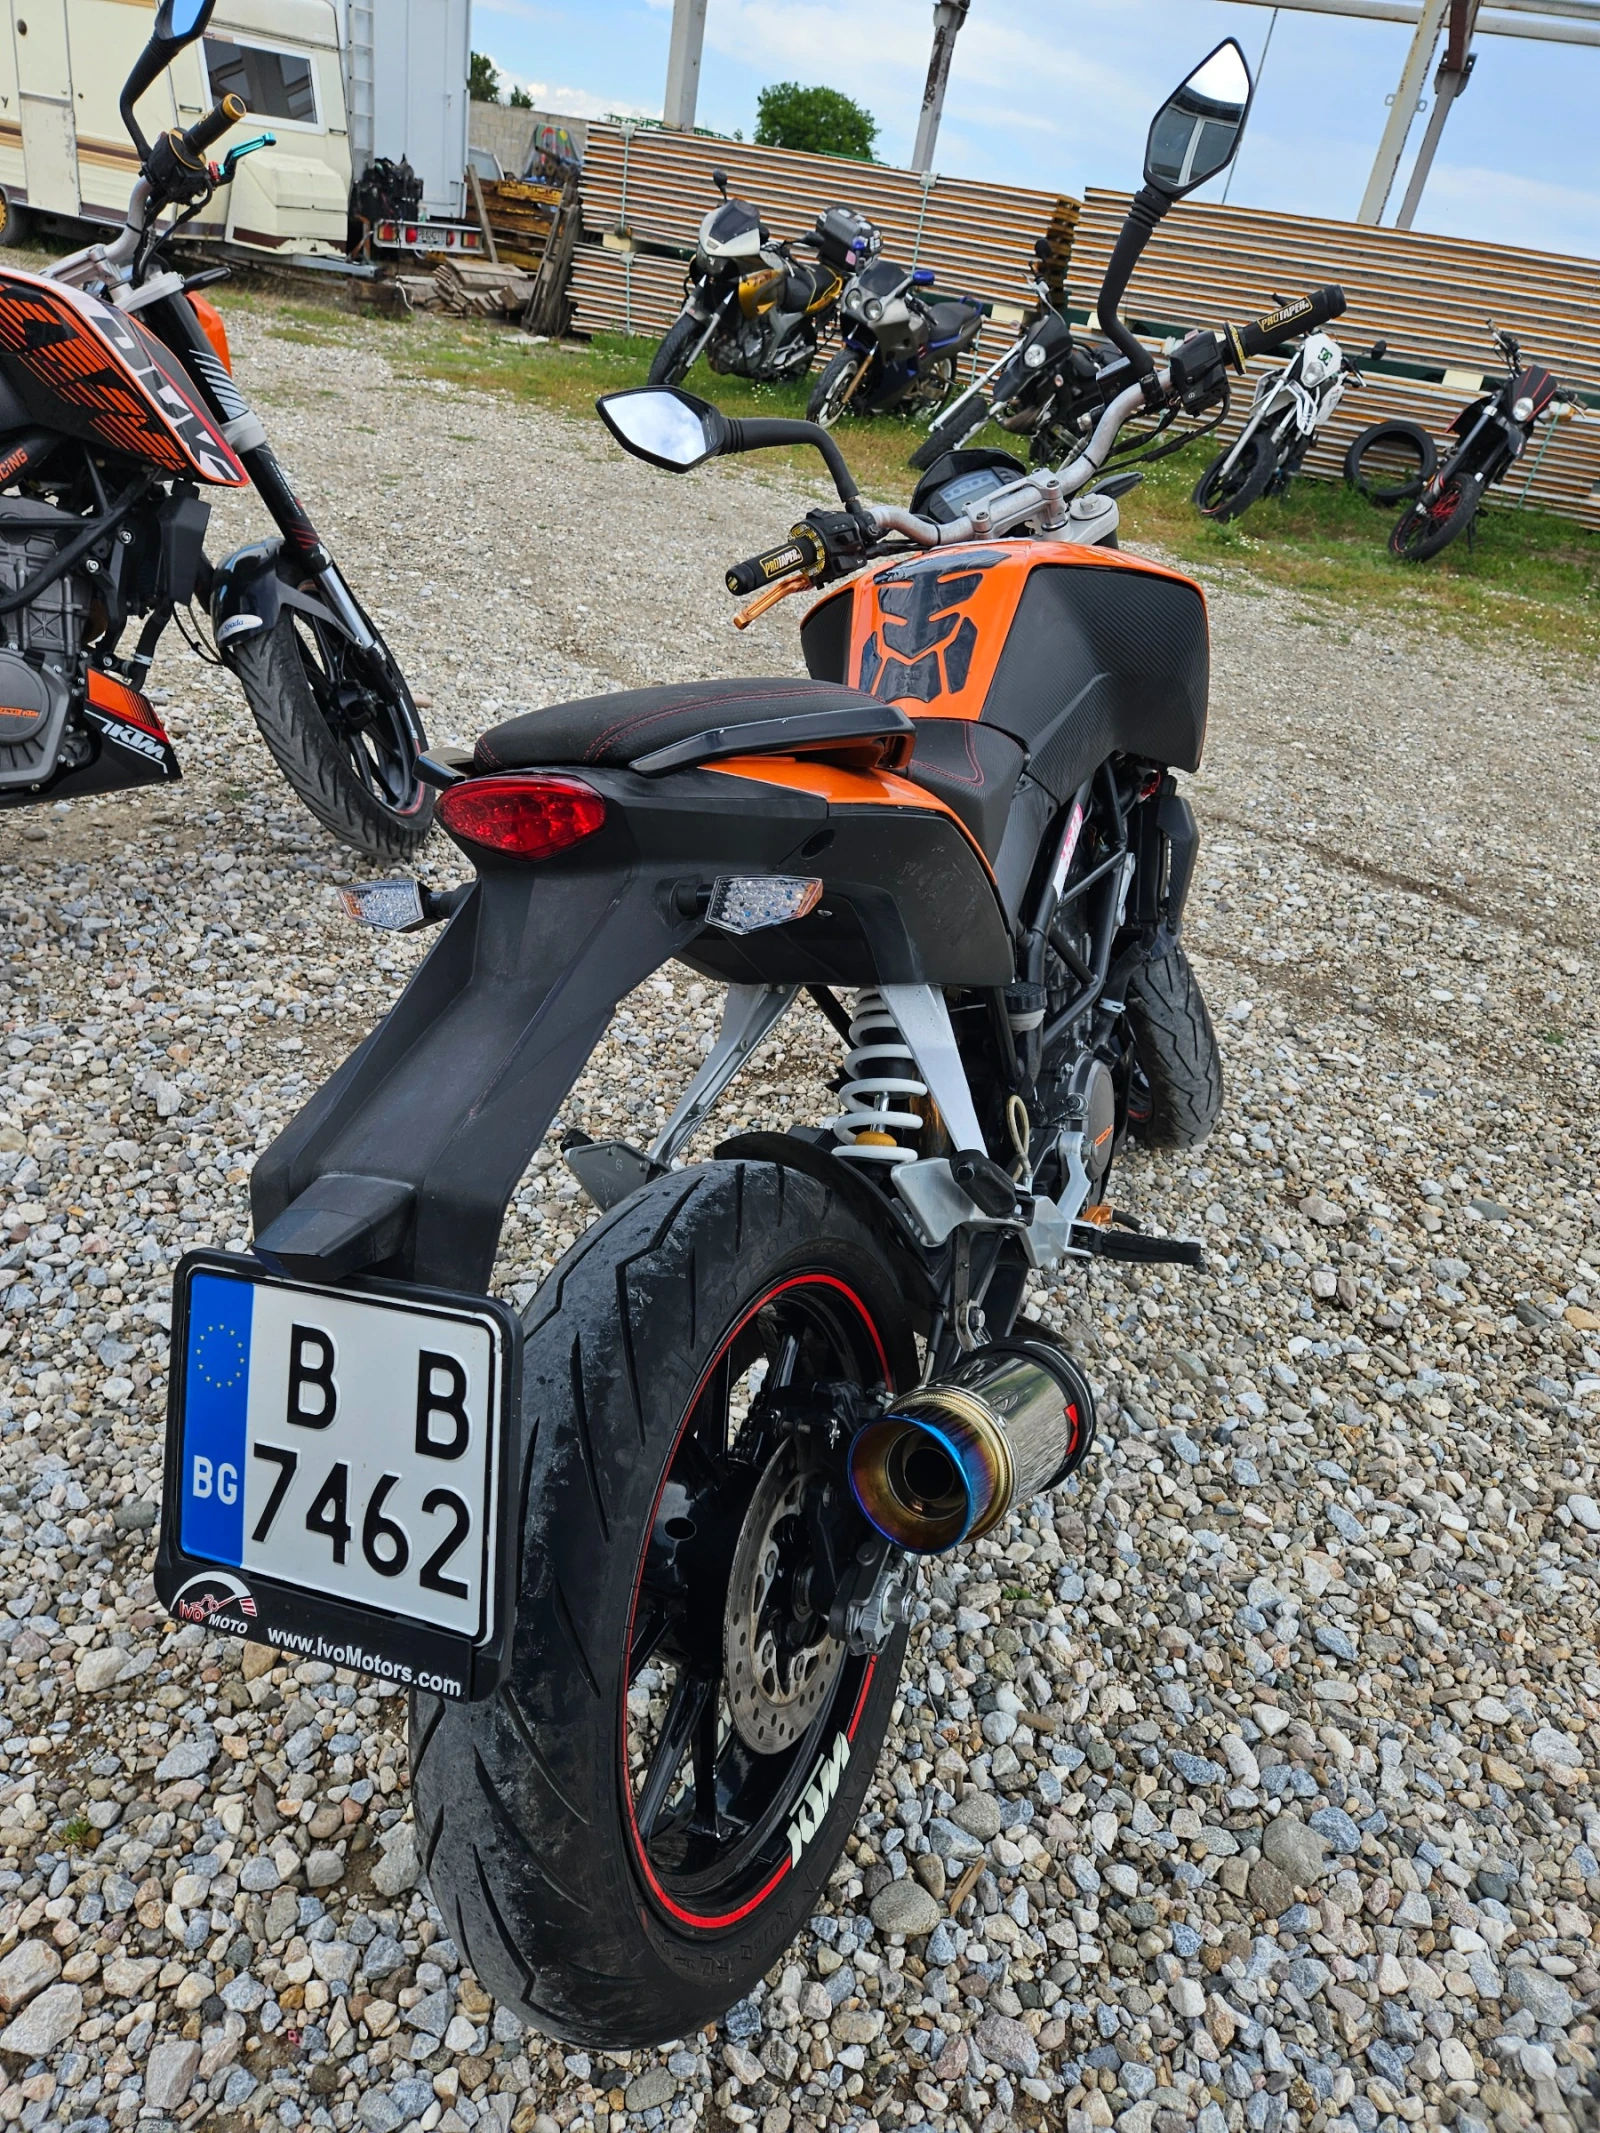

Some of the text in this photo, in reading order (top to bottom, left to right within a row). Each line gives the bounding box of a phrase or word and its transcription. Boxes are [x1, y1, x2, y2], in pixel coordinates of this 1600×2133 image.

[1261, 299, 1310, 328] PROTAPER
[764, 548, 801, 573] PROTAPER
[102, 721, 166, 760] KTM
[286, 1322, 470, 1461] B B
[192, 1455, 238, 1505] BG
[251, 1441, 471, 1601] 7462
[207, 1613, 249, 1635] MOTO
[267, 1627, 462, 1697] www.IvoMotors.com
[786, 1730, 851, 1870] KTM
